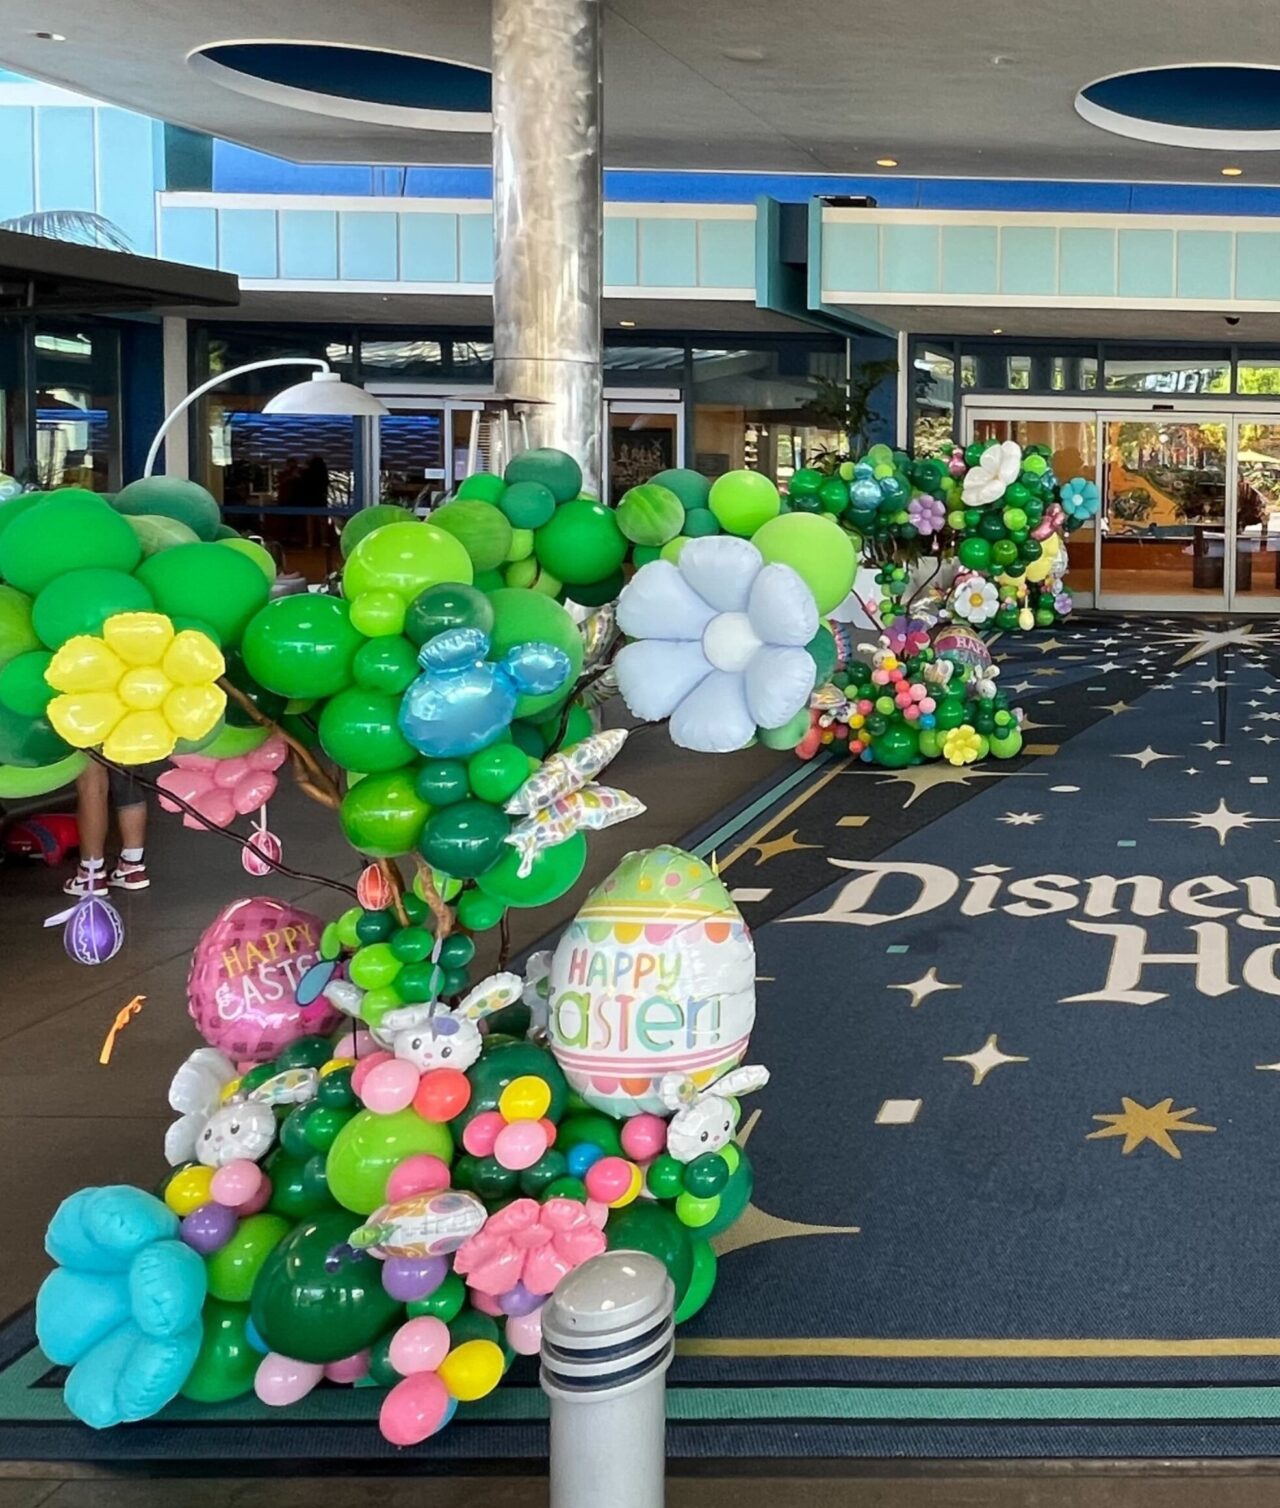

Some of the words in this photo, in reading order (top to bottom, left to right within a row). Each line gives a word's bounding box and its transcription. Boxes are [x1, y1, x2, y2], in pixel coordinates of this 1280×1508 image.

[220, 922, 315, 979] HAPPY
[568, 947, 683, 993] HAPPY
[216, 951, 322, 1020] EASTE
